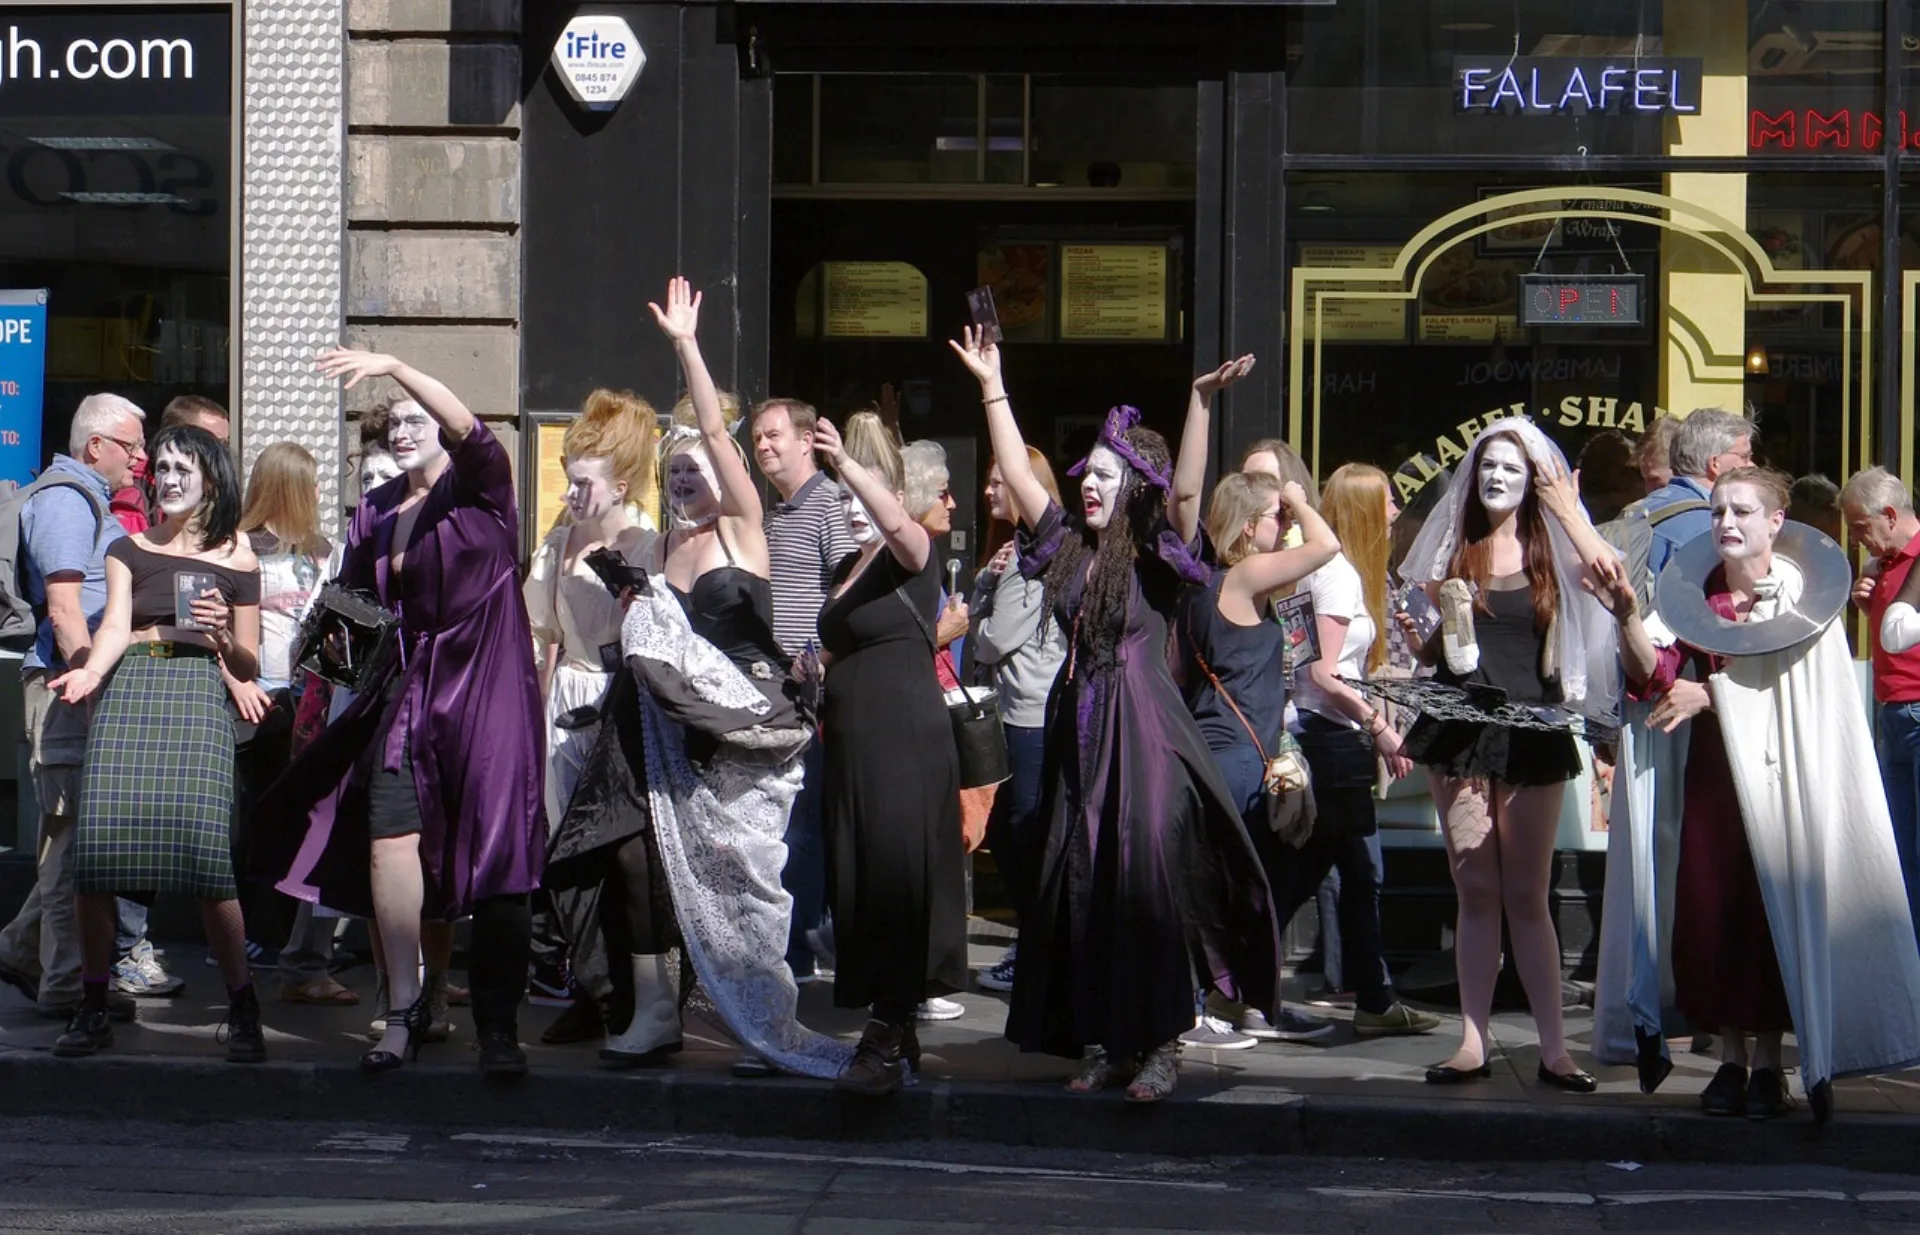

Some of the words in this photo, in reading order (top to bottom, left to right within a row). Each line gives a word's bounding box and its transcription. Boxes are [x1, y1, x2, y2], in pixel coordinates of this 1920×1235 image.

[566, 29, 626, 59] iFire
[0, 25, 193, 88] h.com
[575, 73, 597, 82] 0845
[600, 73, 617, 82] 874
[1461, 67, 1695, 111] FALAFEL
[585, 85, 607, 94] 1234
[1566, 219, 1622, 242] Wraps
[1533, 285, 1630, 316] OPEN
[0, 380, 20, 396] TO:
[1, 430, 20, 445] TO:
